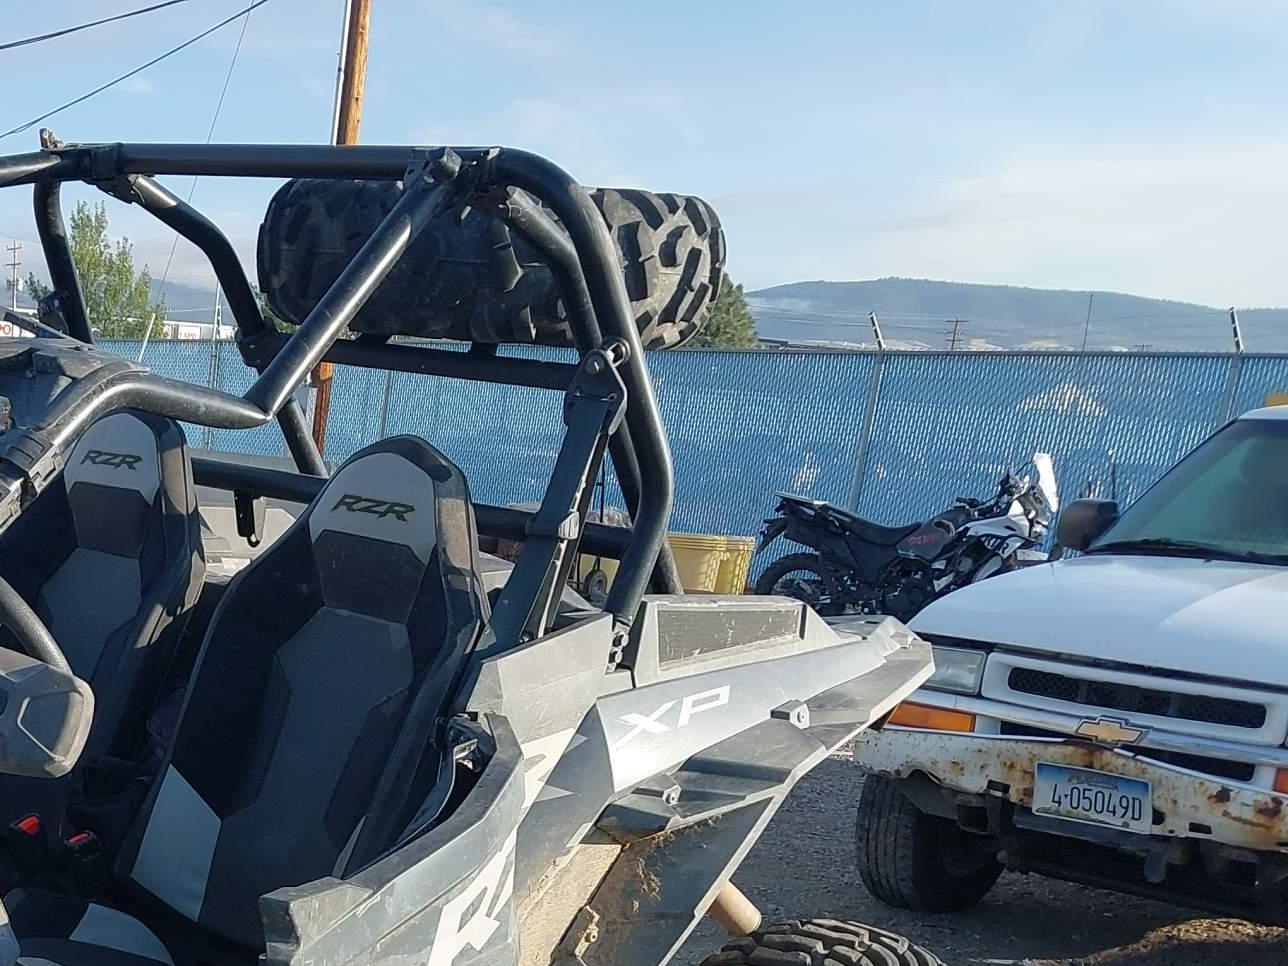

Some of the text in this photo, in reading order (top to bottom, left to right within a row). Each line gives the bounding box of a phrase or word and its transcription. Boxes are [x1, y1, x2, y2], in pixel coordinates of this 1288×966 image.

[79, 449, 143, 471] RZR
[331, 493, 416, 523] RZR
[612, 684, 731, 750] XP
